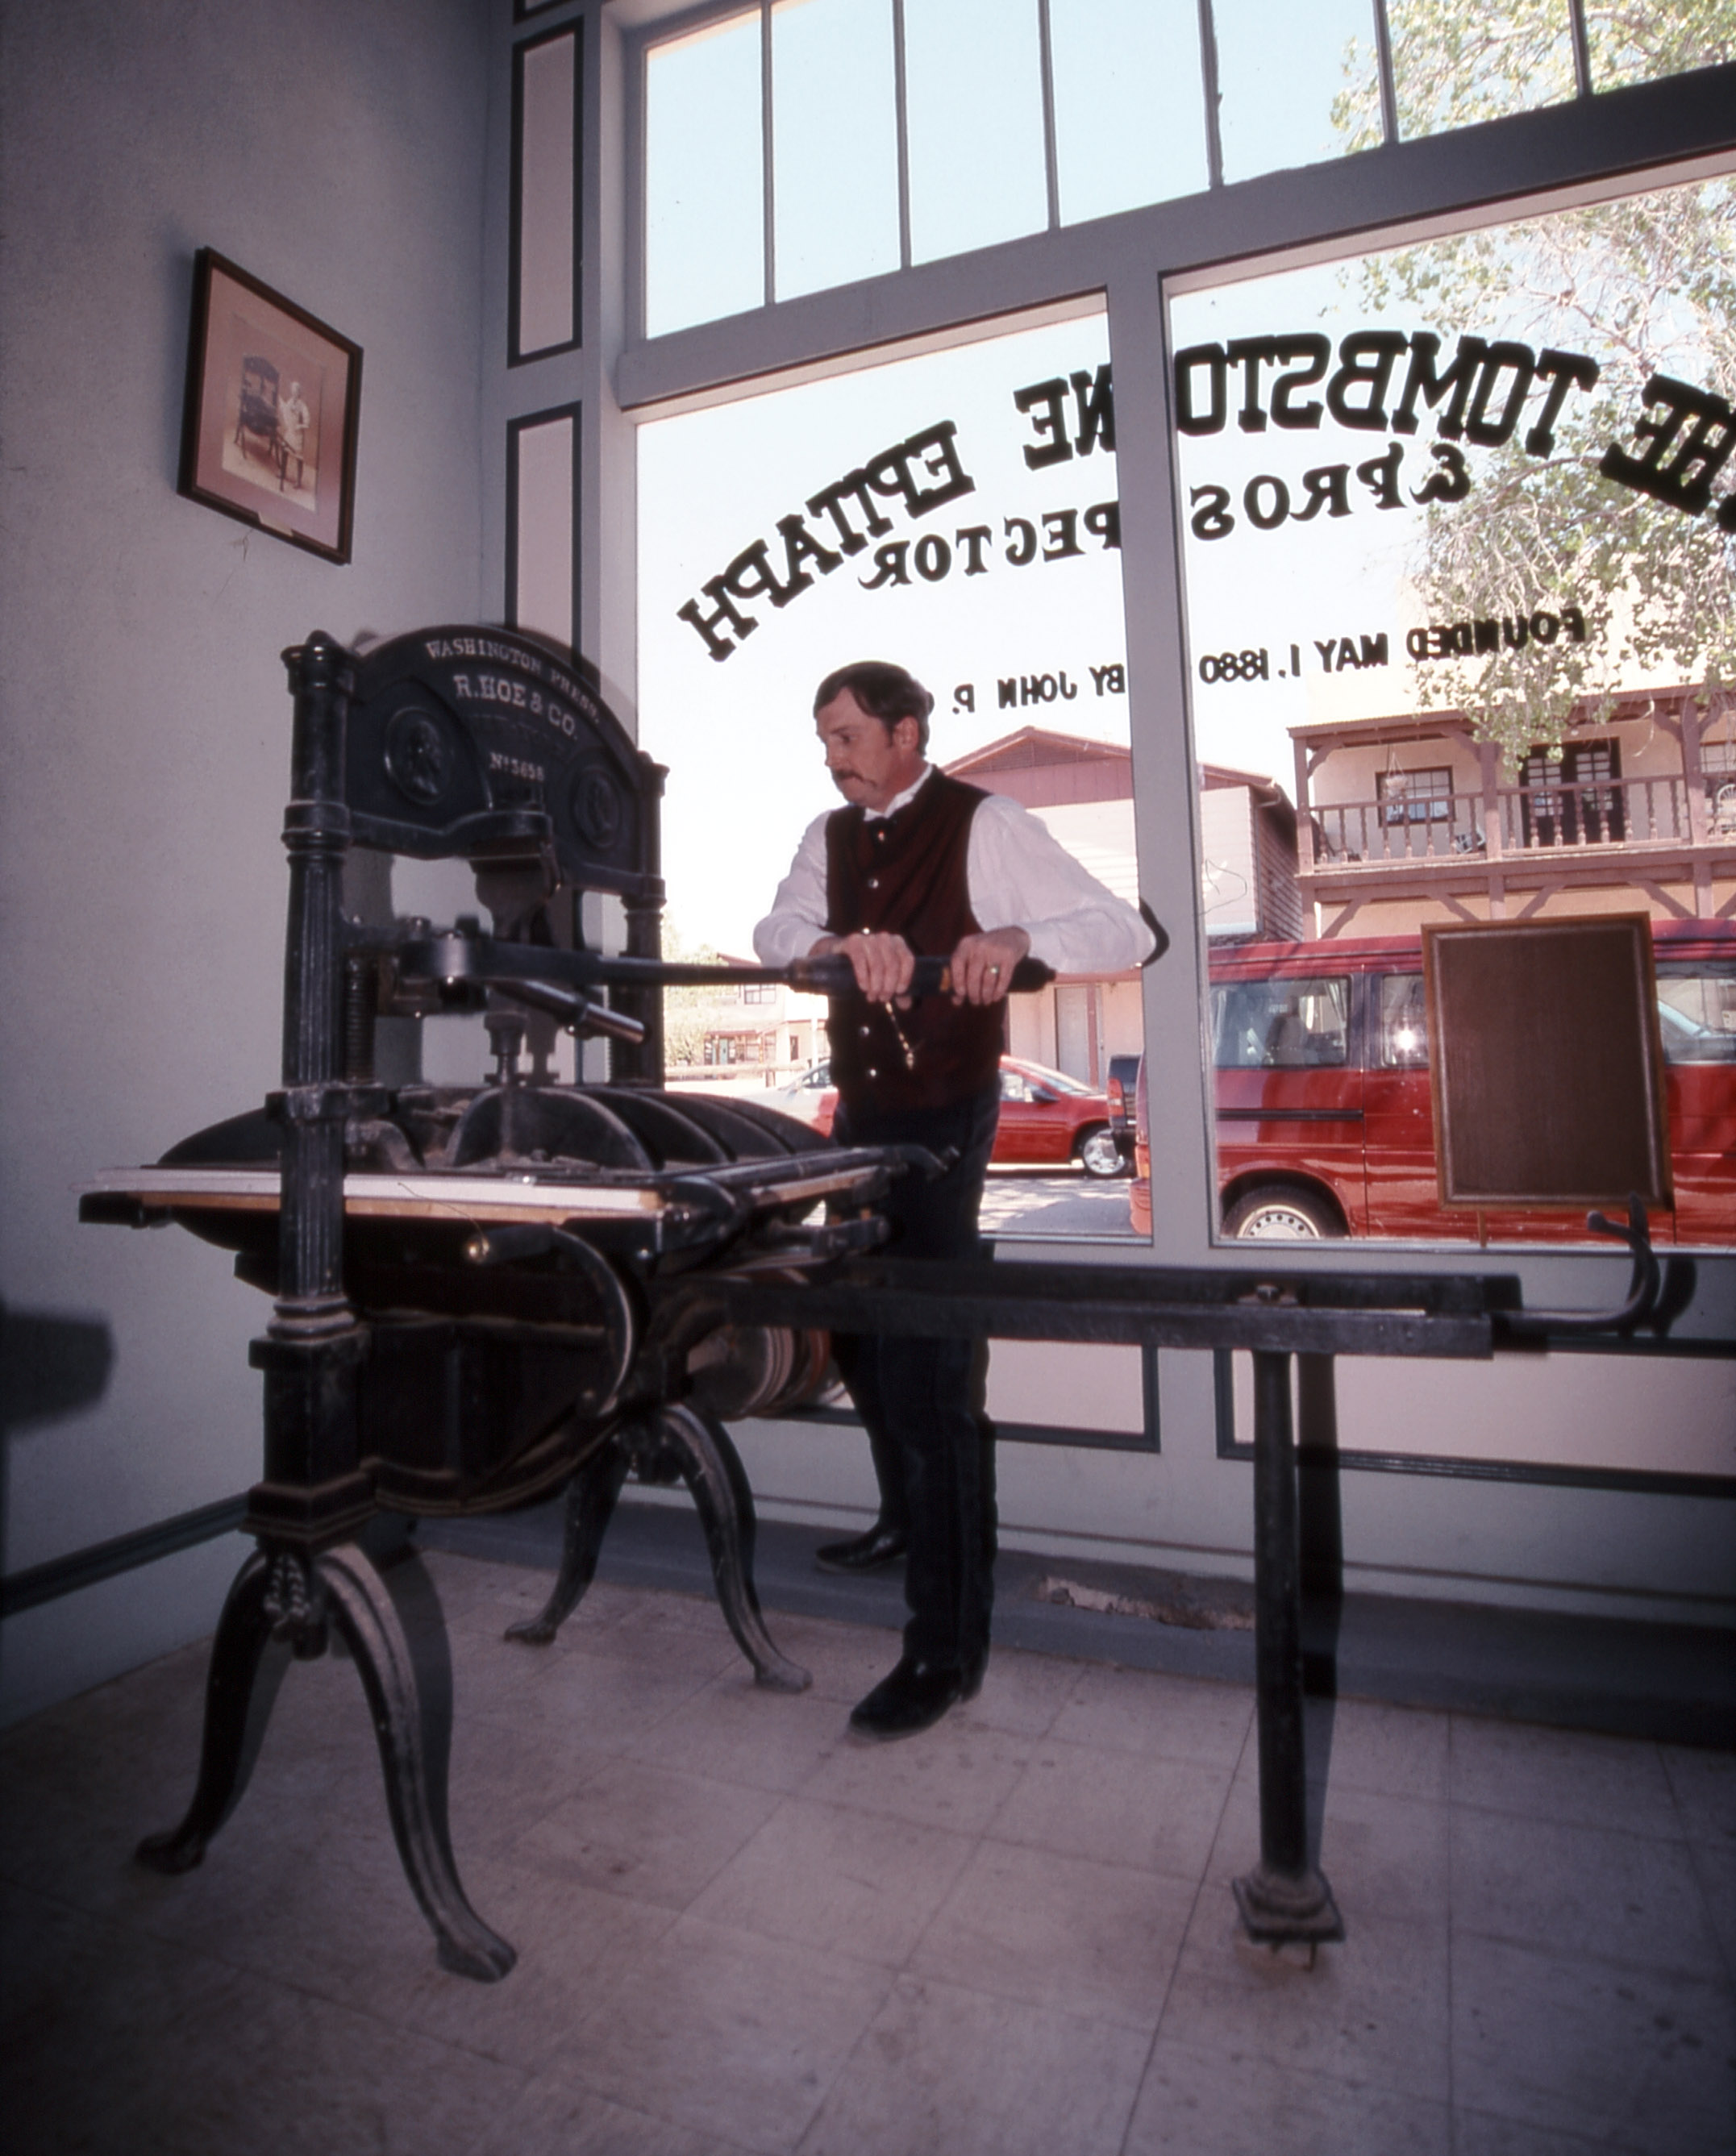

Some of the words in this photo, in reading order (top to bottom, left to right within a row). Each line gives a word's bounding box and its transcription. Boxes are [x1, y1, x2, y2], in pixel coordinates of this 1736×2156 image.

[425, 638, 542, 674] WASHINGTON
[529, 691, 543, 714] &
[547, 703, 578, 740] CO.
